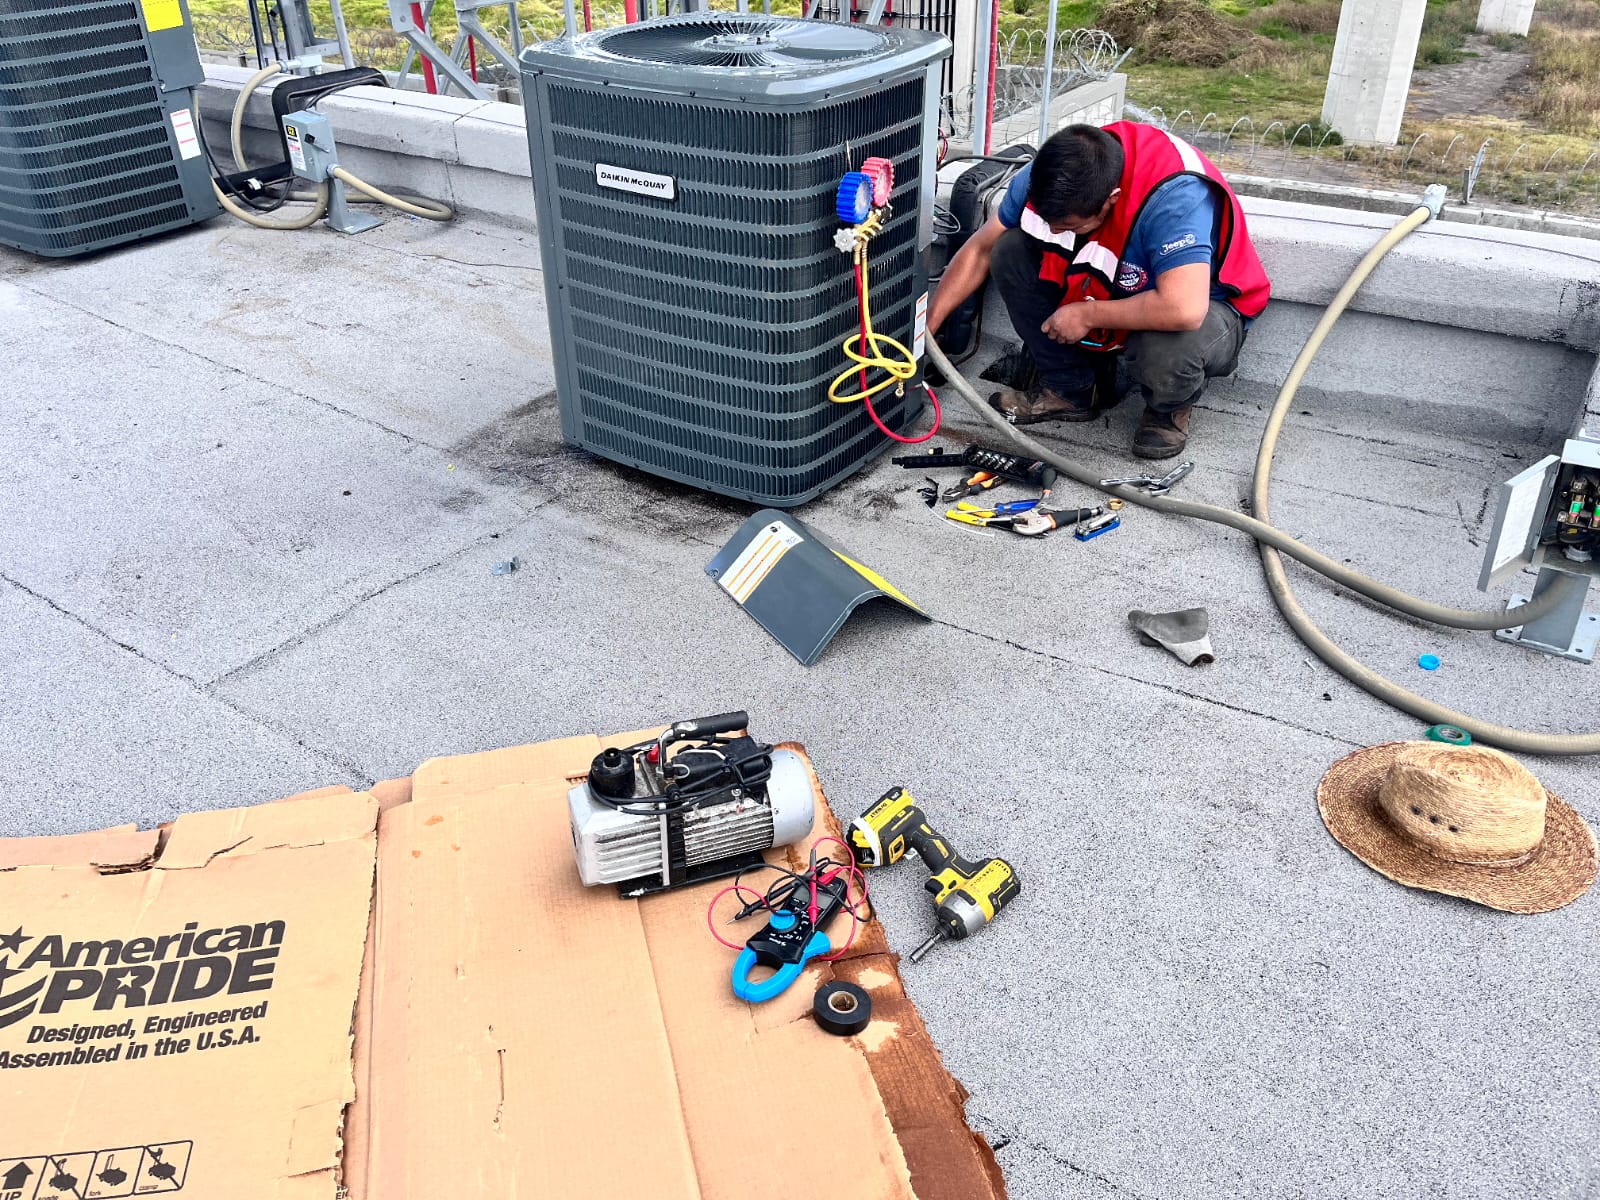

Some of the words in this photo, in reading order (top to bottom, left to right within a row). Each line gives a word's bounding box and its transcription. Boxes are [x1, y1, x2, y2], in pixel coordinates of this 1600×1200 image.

[600, 171, 630, 183] DAIKIN
[631, 178, 666, 190] McQUAY
[1162, 239, 1186, 252] Jeep
[18, 919, 286, 969] American
[39, 946, 281, 1014] PRIDE
[26, 1019, 136, 1044] Designed,
[143, 1000, 268, 1034] Engineered
[0, 1043, 122, 1069] Assembled
[125, 1041, 148, 1060] in
[154, 1037, 191, 1056] the
[197, 1025, 261, 1050] U.S.A.
